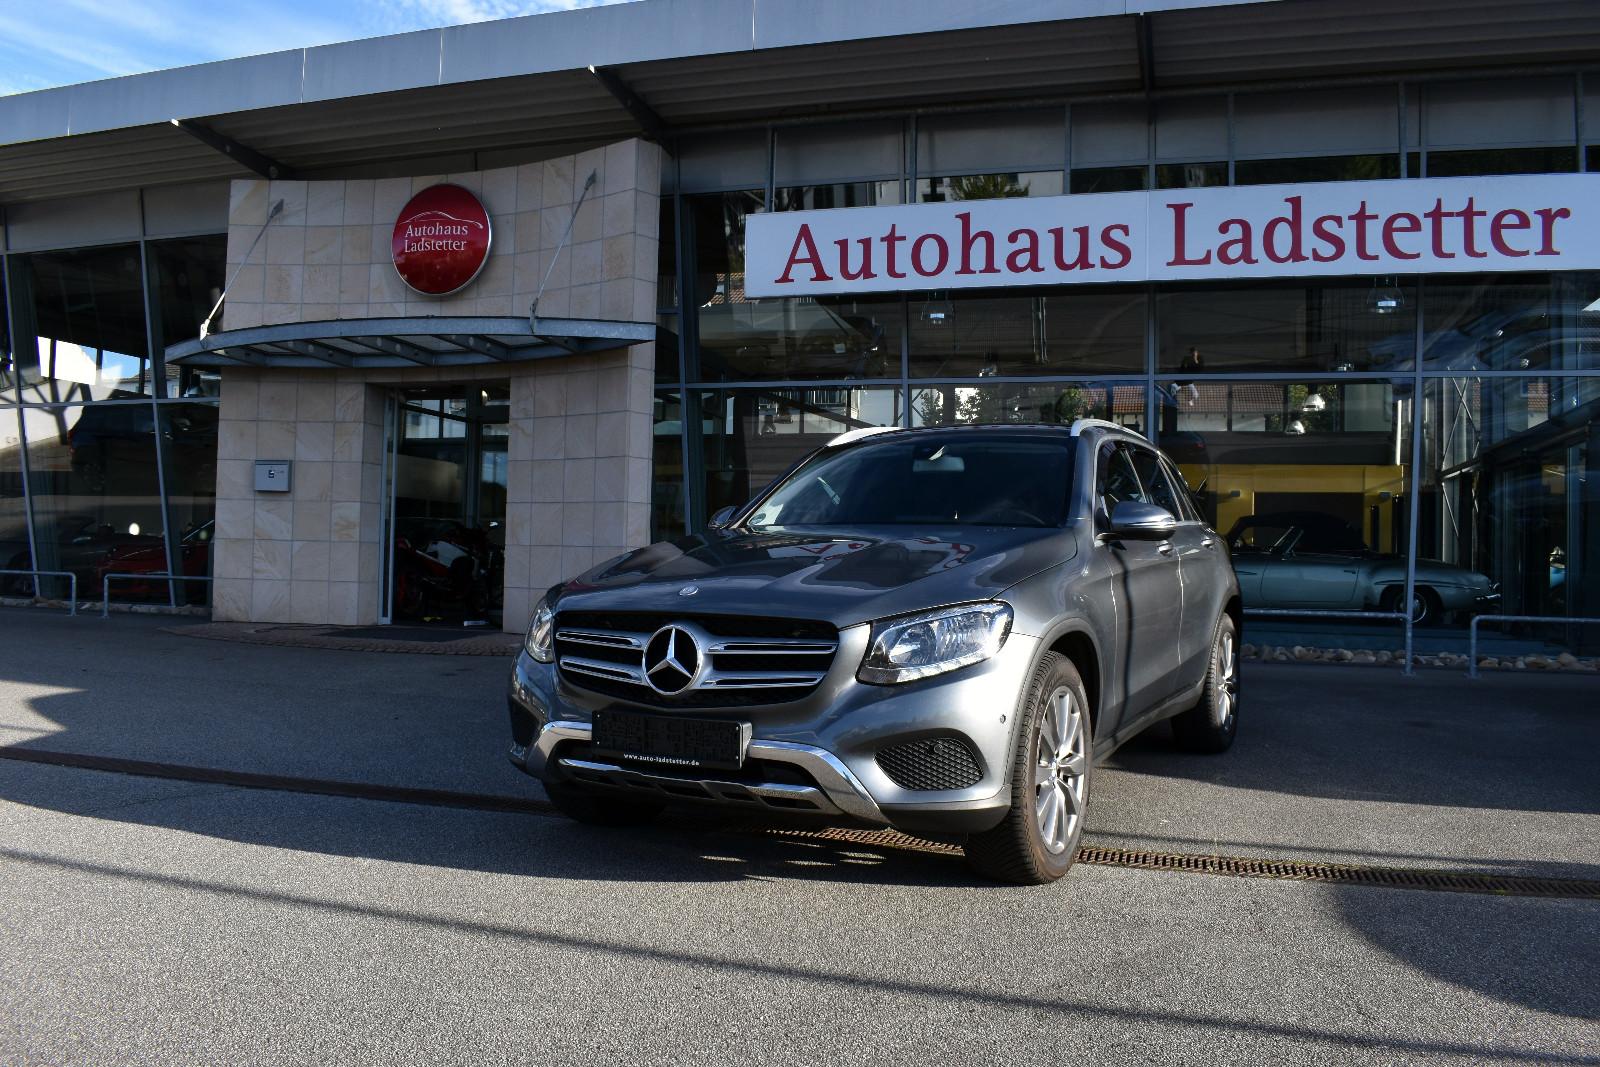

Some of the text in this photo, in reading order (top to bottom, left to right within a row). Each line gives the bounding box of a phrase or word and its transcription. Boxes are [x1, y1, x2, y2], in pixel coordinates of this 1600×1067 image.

[404, 222, 468, 238] Autohaus
[404, 238, 467, 253] Ladstetter
[774, 195, 1571, 283] Autohaus Ladstetter
[623, 753, 700, 766] www.auto-ladstetter.de
